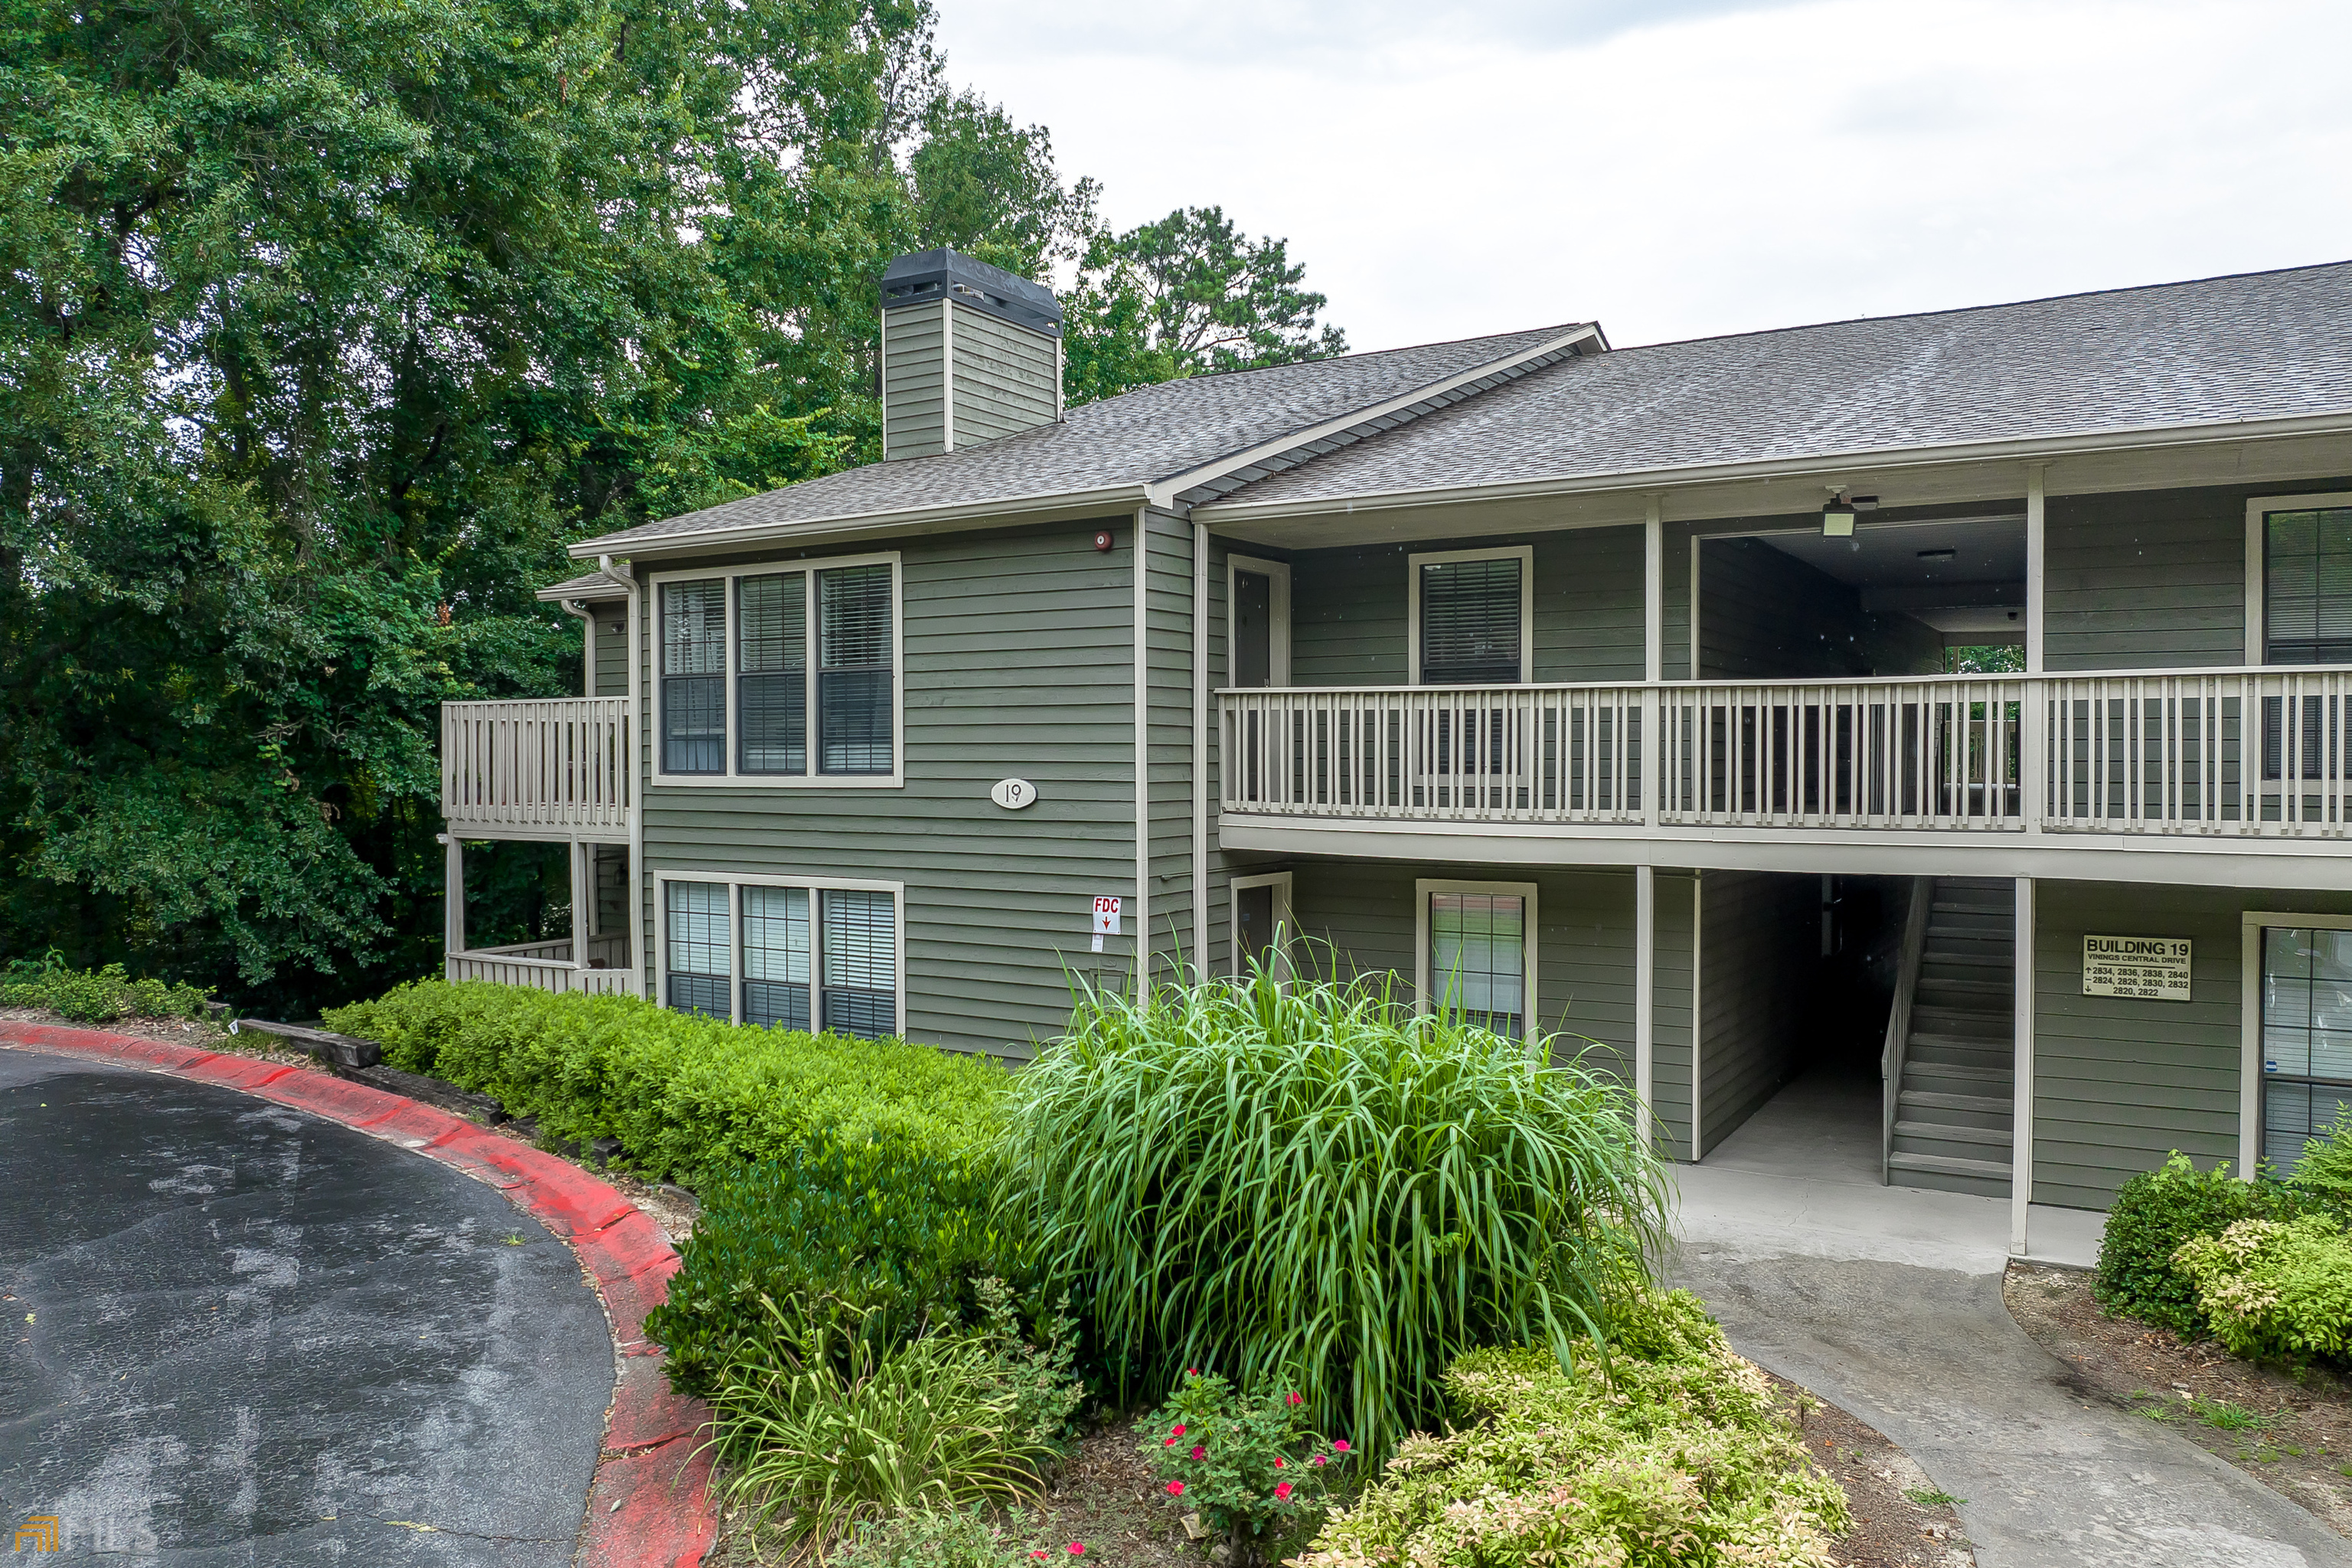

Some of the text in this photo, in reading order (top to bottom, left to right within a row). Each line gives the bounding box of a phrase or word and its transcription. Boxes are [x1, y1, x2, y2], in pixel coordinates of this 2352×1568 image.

[1005, 784, 1022, 803] 19
[1095, 897, 1119, 913] FDC
[2086, 939, 2189, 956] BUILDING 19
[2088, 953, 2120, 962] VININGS
[2122, 955, 2159, 963] CENTRAL
[2092, 967, 2188, 979] 2834, 2836, 2838, 2840
[2092, 977, 2189, 989] 2824, 2826, 2830, 2832
[2113, 987, 2159, 997] 2820, 2822
